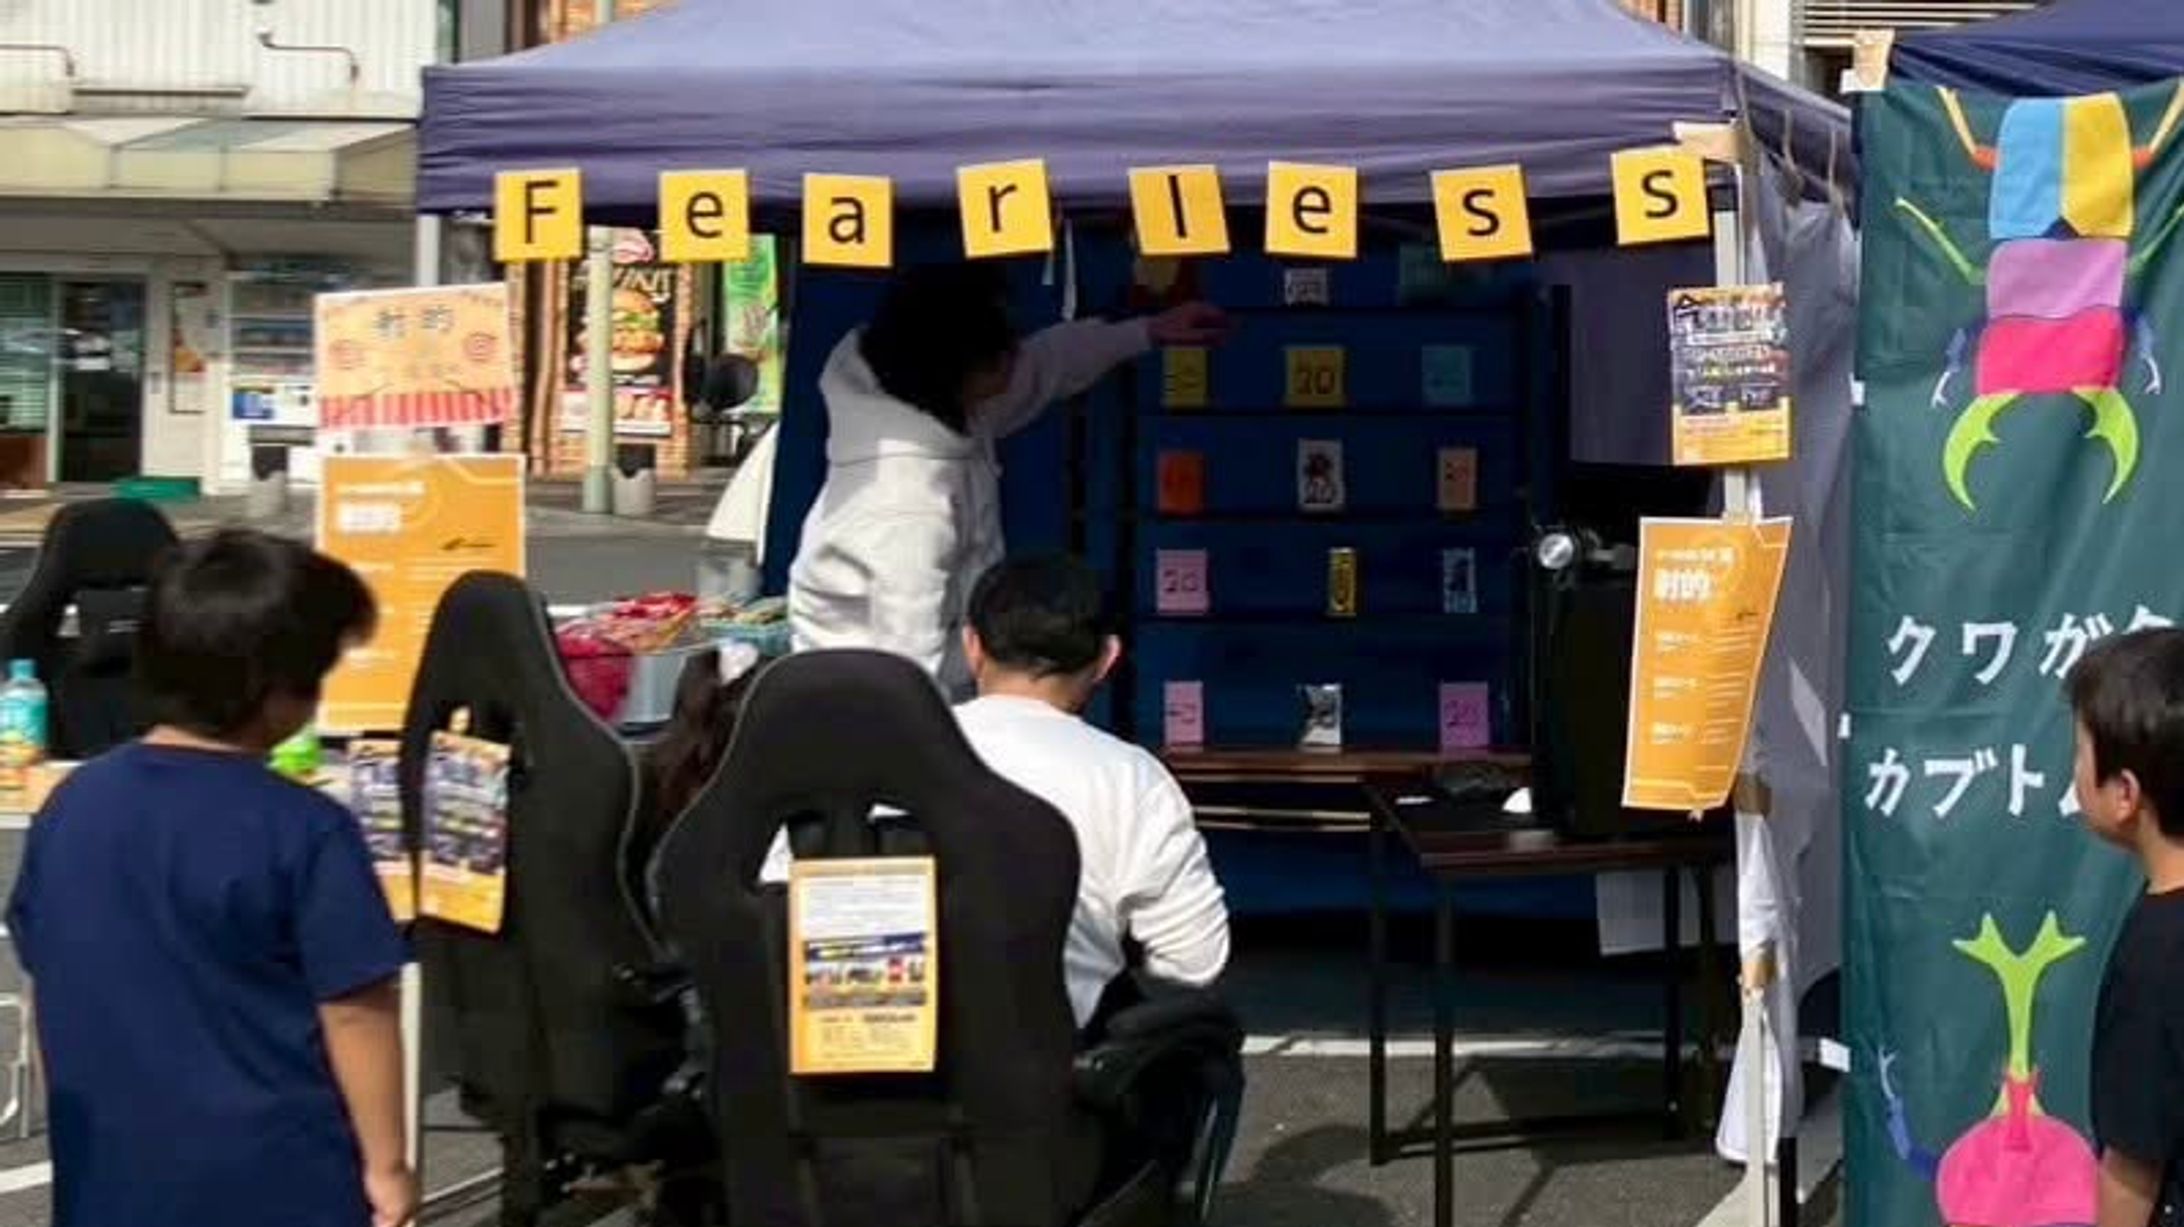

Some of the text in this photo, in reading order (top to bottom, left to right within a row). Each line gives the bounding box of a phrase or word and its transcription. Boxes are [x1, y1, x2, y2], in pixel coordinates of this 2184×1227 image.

[523, 168, 1680, 246] Fearless
[1864, 743, 2083, 819] カブト
